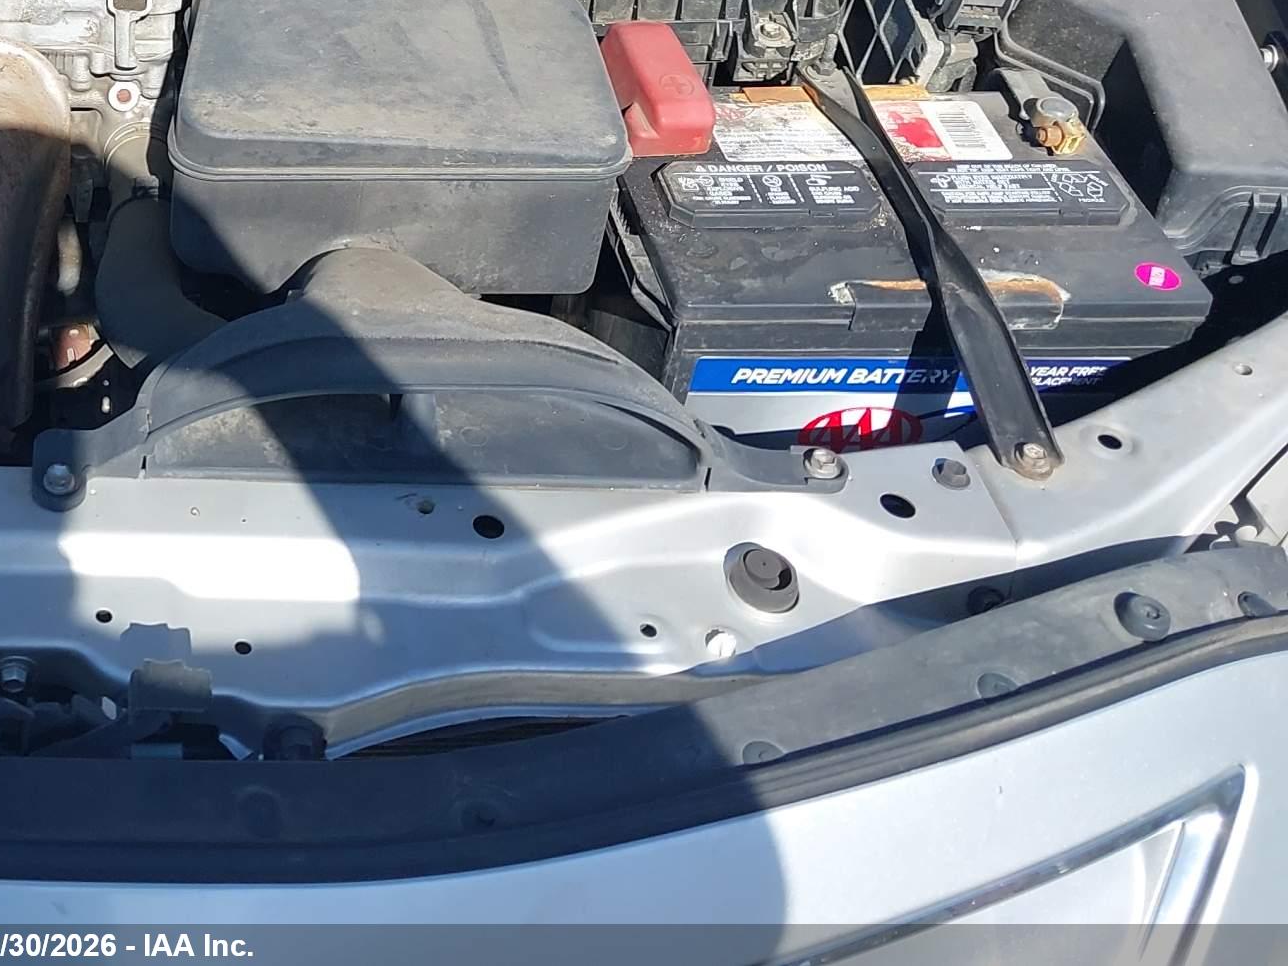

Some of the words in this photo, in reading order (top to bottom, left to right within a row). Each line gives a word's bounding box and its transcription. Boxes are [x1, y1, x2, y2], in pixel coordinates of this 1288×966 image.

[708, 164, 762, 172] DANGER
[775, 163, 828, 172] POISON
[731, 368, 848, 384] PREMIUM
[846, 368, 956, 384] BATTERY
[1029, 366, 1068, 376] YEAR
[800, 408, 922, 452] AAA
